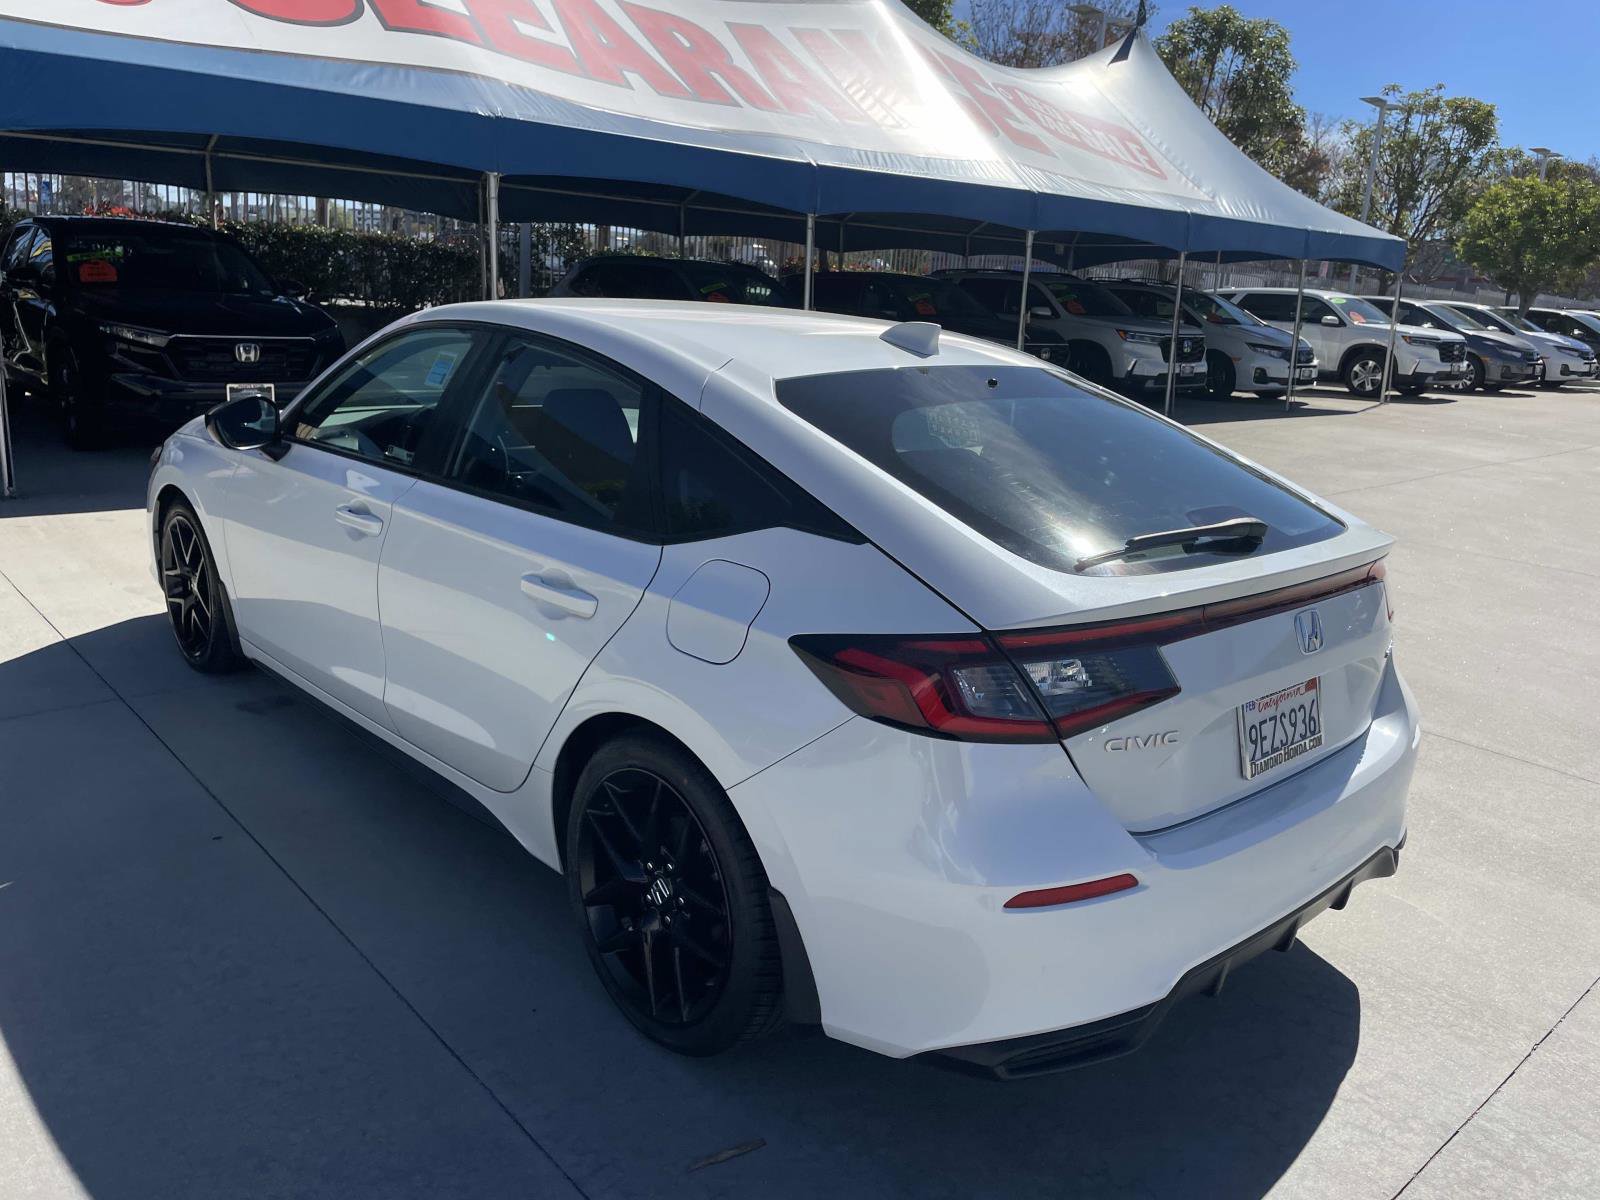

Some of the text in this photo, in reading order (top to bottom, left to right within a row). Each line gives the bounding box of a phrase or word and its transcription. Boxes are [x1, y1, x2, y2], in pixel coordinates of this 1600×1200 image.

[238, 0, 1060, 157] LEARANE
[1066, 116, 1162, 175] SALE
[1245, 700, 1256, 713] FEB
[1258, 686, 1306, 713] California
[1104, 729, 1180, 752] CIVIC
[1248, 698, 1318, 762] 9EZS936
